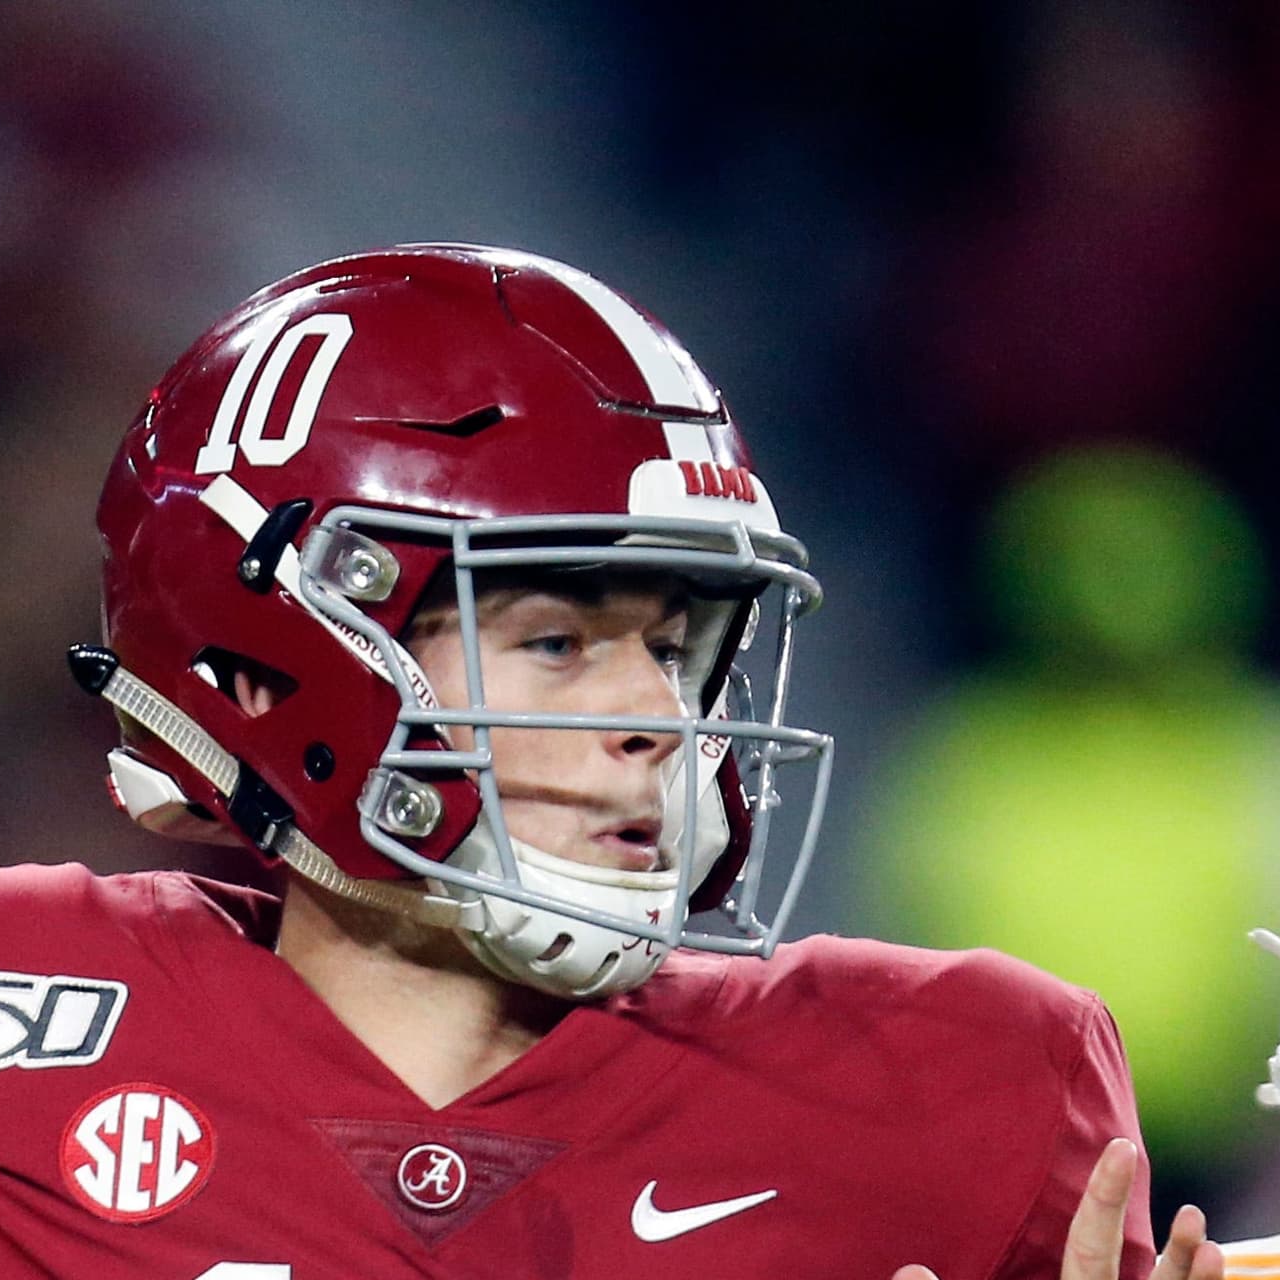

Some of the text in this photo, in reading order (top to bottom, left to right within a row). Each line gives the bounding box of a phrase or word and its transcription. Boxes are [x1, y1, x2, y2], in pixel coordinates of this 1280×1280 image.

[194, 313, 354, 475] 10
[678, 460, 759, 504] BAMA
[74, 1091, 204, 1214] SEC
[406, 1152, 454, 1196] A
